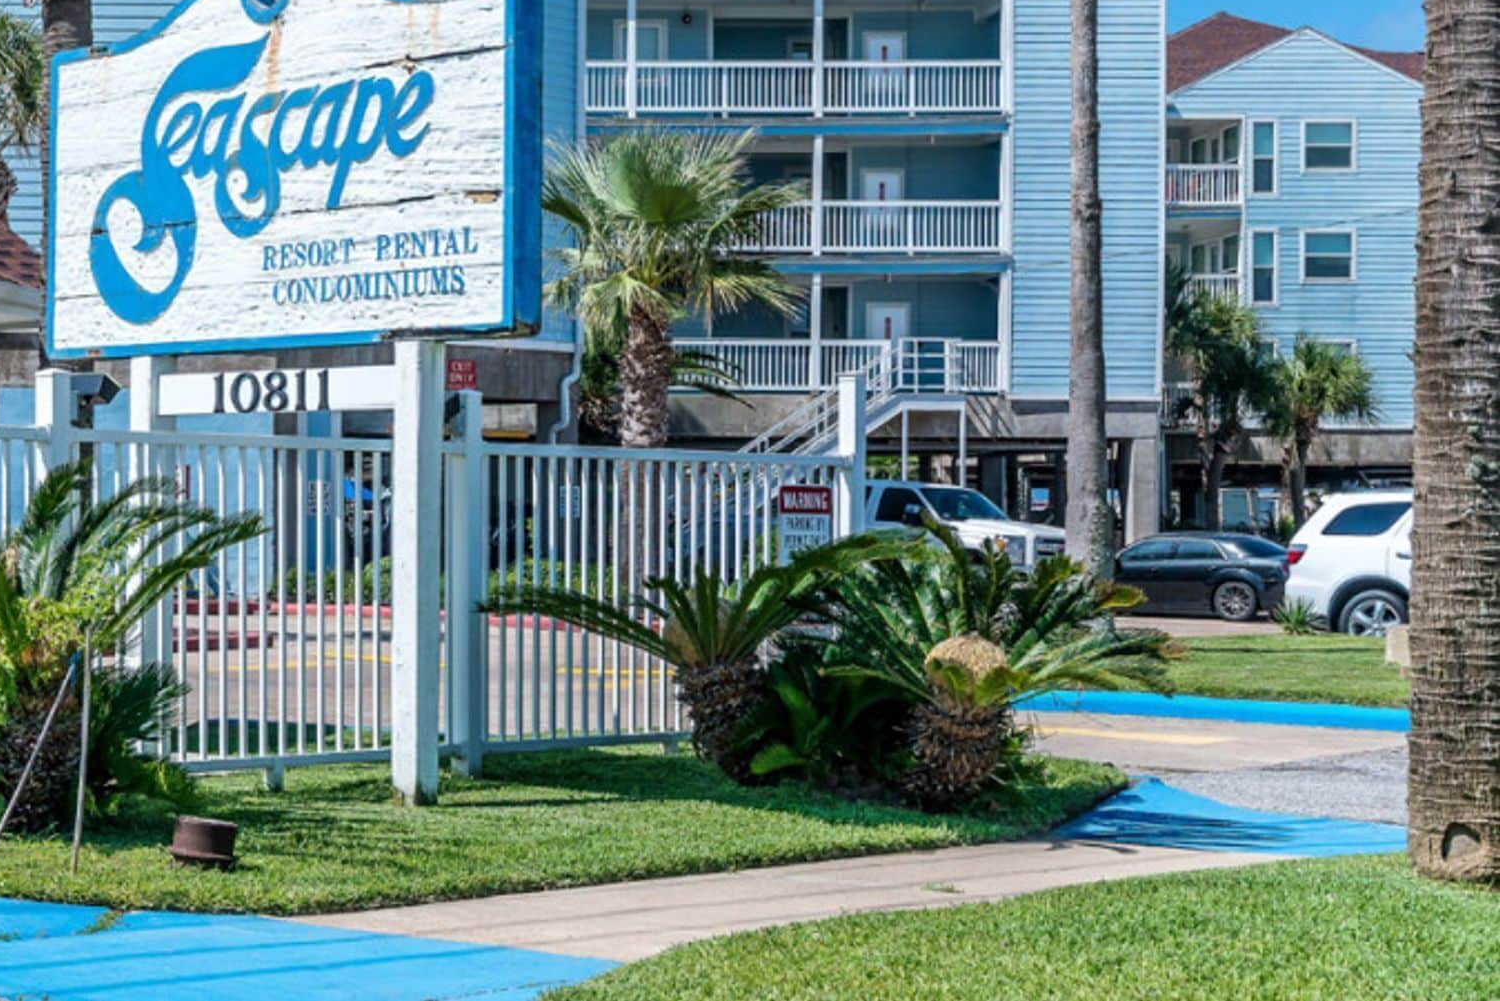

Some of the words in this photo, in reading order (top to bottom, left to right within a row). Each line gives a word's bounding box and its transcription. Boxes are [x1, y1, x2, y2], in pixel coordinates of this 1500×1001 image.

[89, 31, 436, 325] Seascape
[262, 238, 355, 271] RESORT
[272, 265, 467, 306] CONDOMINIUMS
[213, 368, 329, 413] 10811
[783, 490, 829, 511] WARNING
